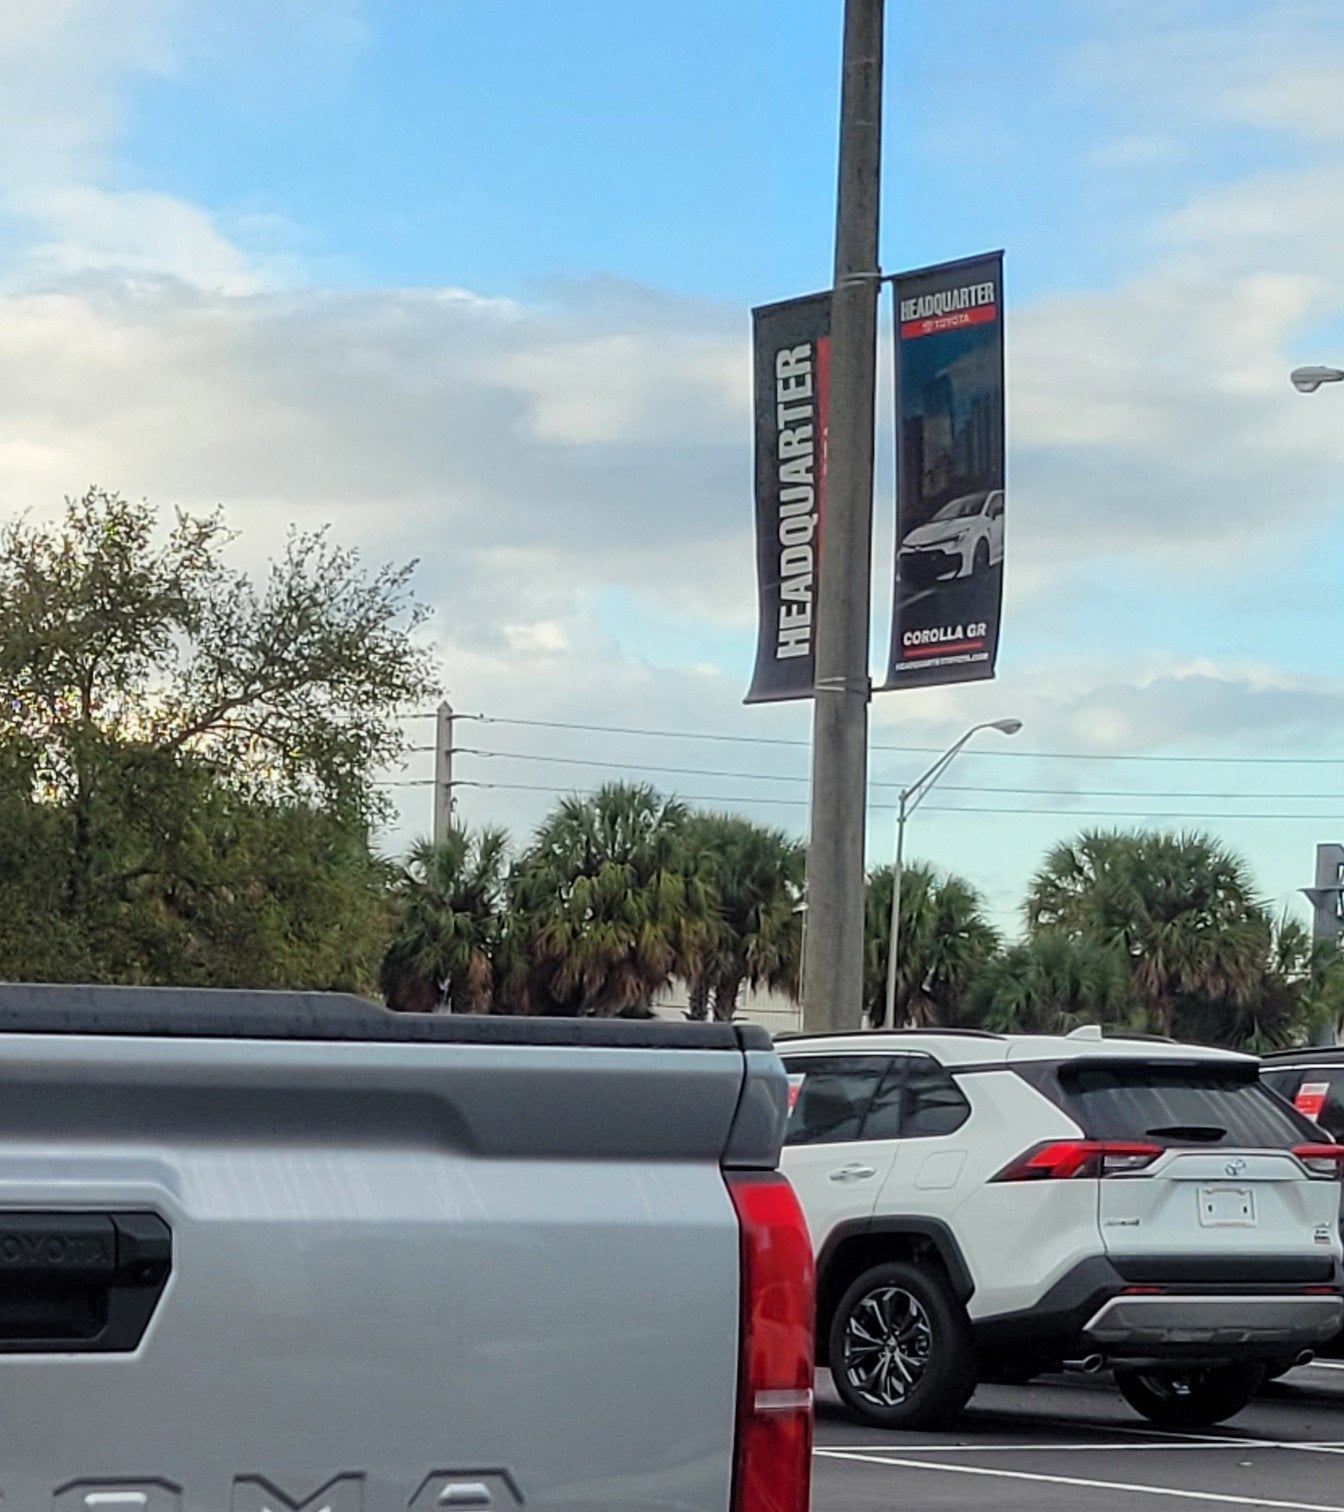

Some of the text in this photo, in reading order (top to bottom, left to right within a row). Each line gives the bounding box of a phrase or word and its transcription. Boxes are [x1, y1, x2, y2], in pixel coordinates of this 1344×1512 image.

[900, 282, 995, 321] HEADQUARTER
[776, 343, 818, 659] HEADQUARTER
[903, 622, 987, 646] COROLLA GR
